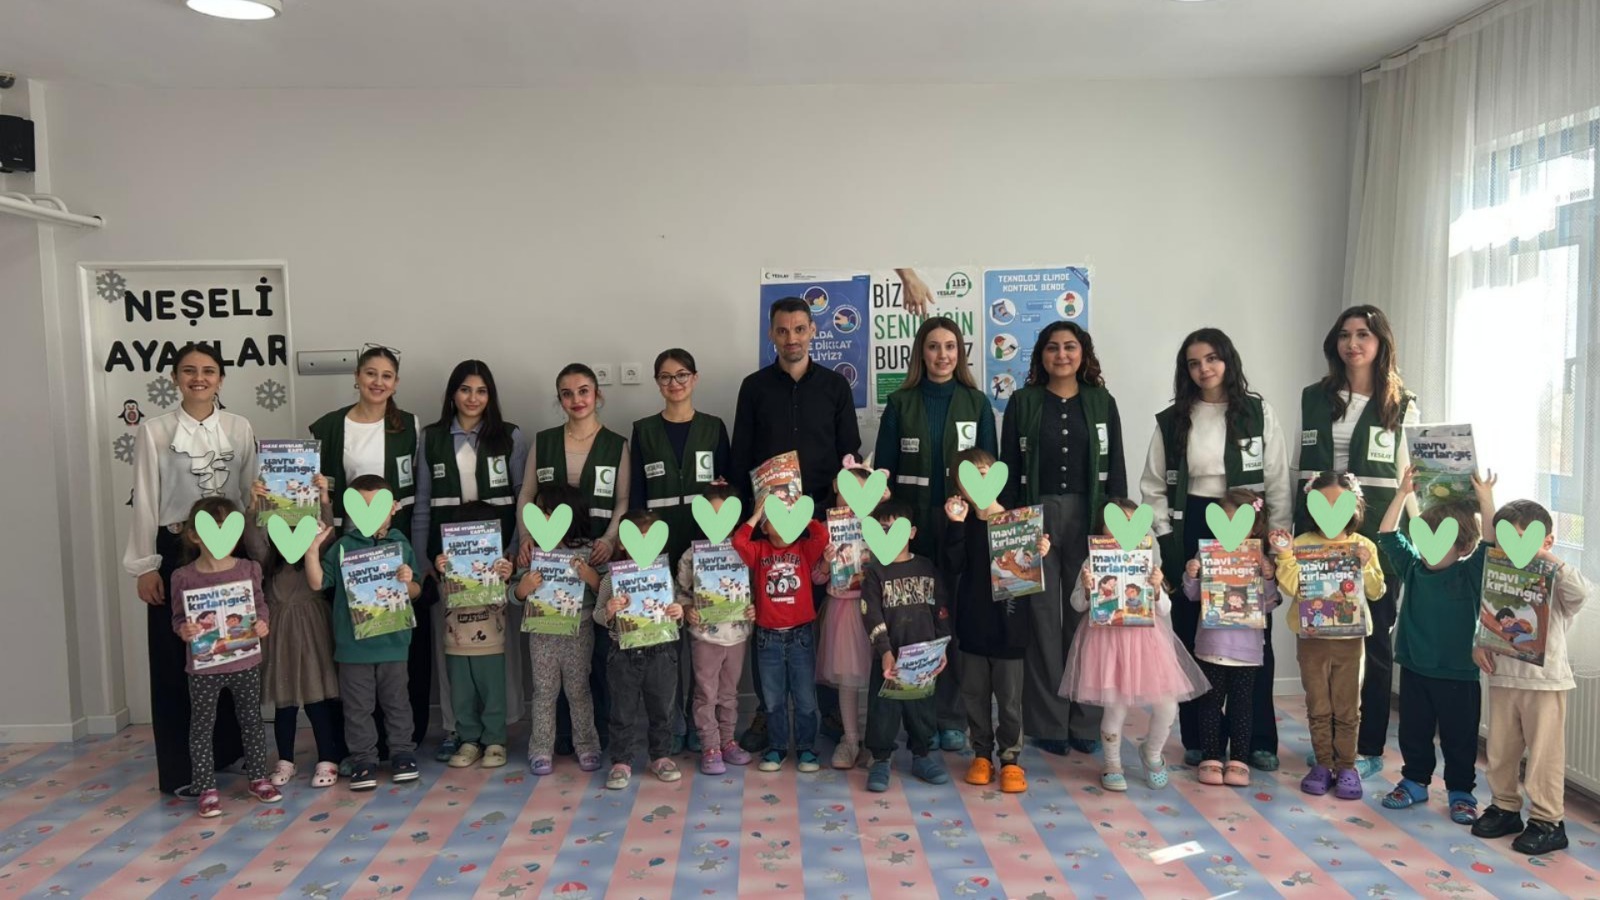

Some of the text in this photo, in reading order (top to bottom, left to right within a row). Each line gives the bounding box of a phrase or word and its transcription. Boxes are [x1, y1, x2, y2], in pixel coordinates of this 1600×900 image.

[952, 279, 966, 287] 115
[1002, 283, 1066, 293] KONTROL BENDE
[873, 279, 902, 309] BİZ
[124, 277, 273, 326] NEŞELİ
[815, 340, 852, 351] DİKKAT
[105, 334, 287, 372] AYALAR
[1413, 443, 1446, 452] yavru
[264, 458, 296, 468] yavru
[830, 524, 855, 533] mavi
[991, 526, 1016, 539] mavi
[448, 540, 479, 549] yavru
[1092, 554, 1121, 563] mavi
[1202, 557, 1231, 566] mavi
[348, 565, 379, 578] yavru
[1299, 562, 1329, 571] mavi
[1487, 568, 1519, 583] mavi
[617, 576, 648, 587] yavru
[186, 590, 220, 602] mavi
